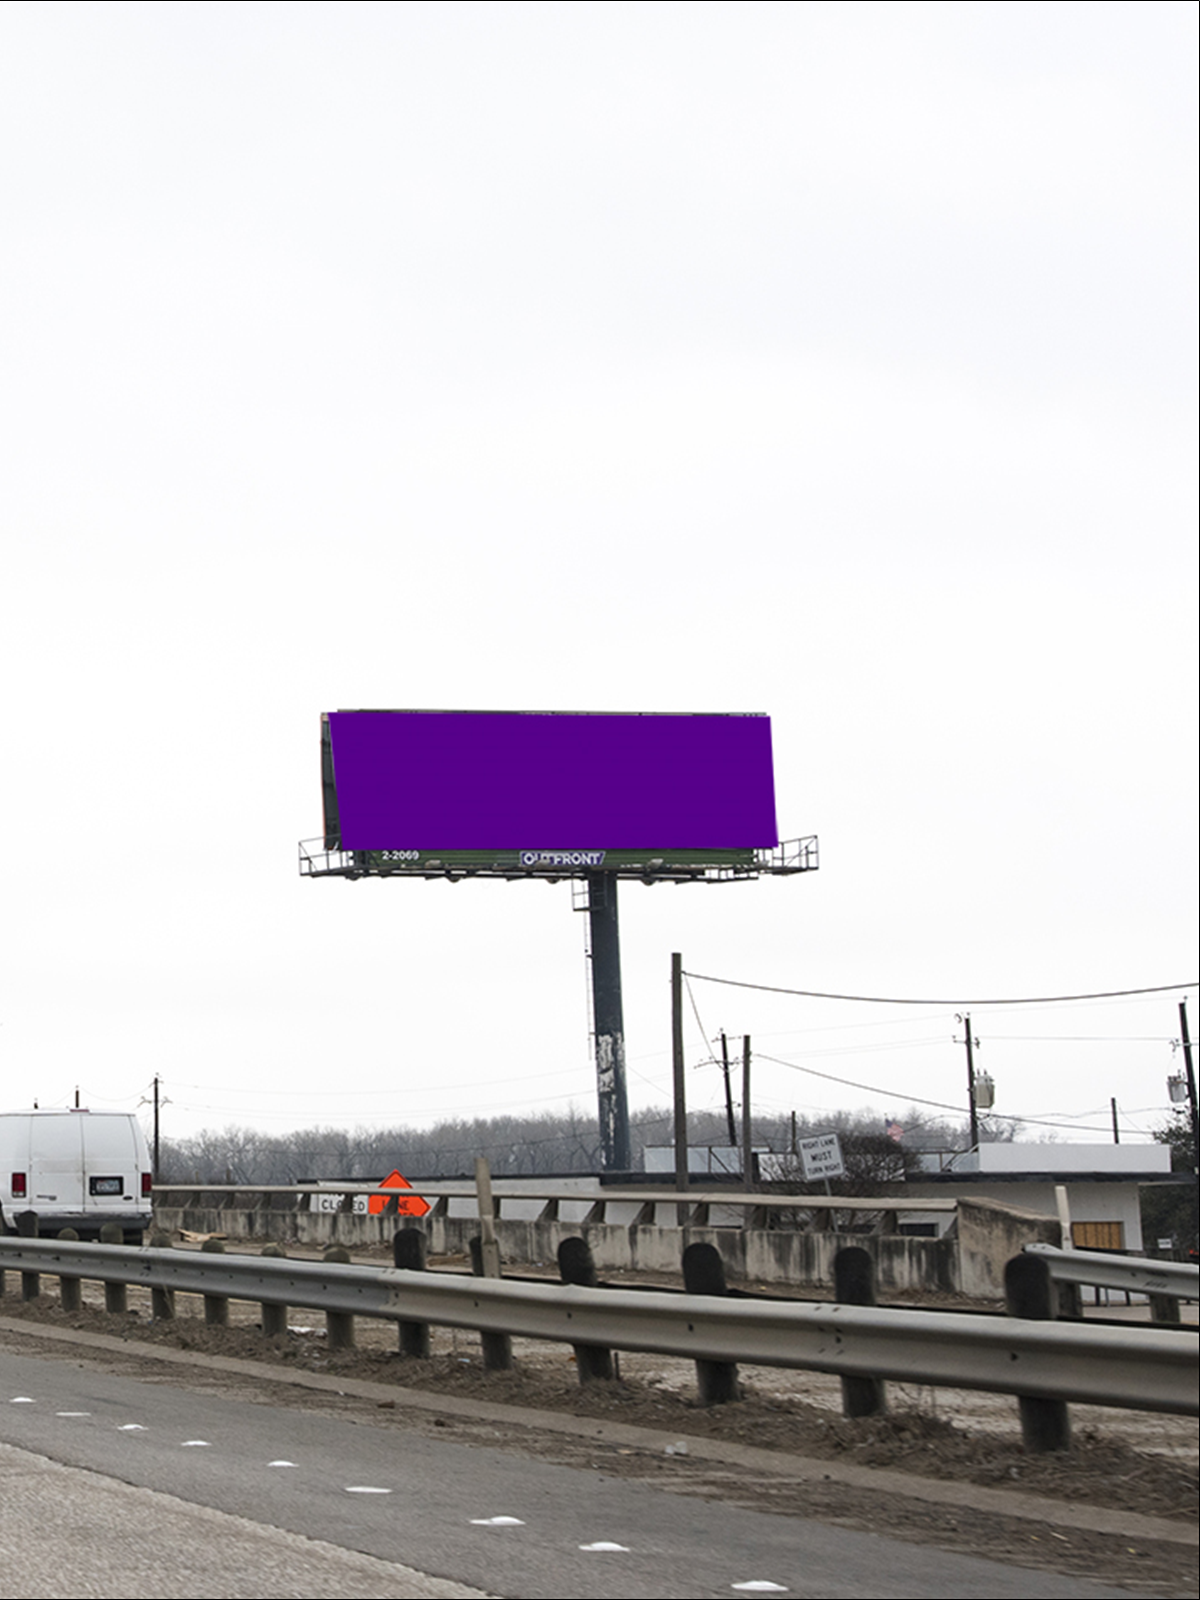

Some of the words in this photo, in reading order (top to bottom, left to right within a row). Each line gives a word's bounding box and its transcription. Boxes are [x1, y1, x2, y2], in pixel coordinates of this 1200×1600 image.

[382, 850, 420, 860] 2-2069
[802, 1140, 819, 1149] RIGHT
[820, 1137, 836, 1147] LANE
[811, 1150, 832, 1162] MUST
[807, 1166, 823, 1175] TURN
[322, 1199, 365, 1212] CLOED
